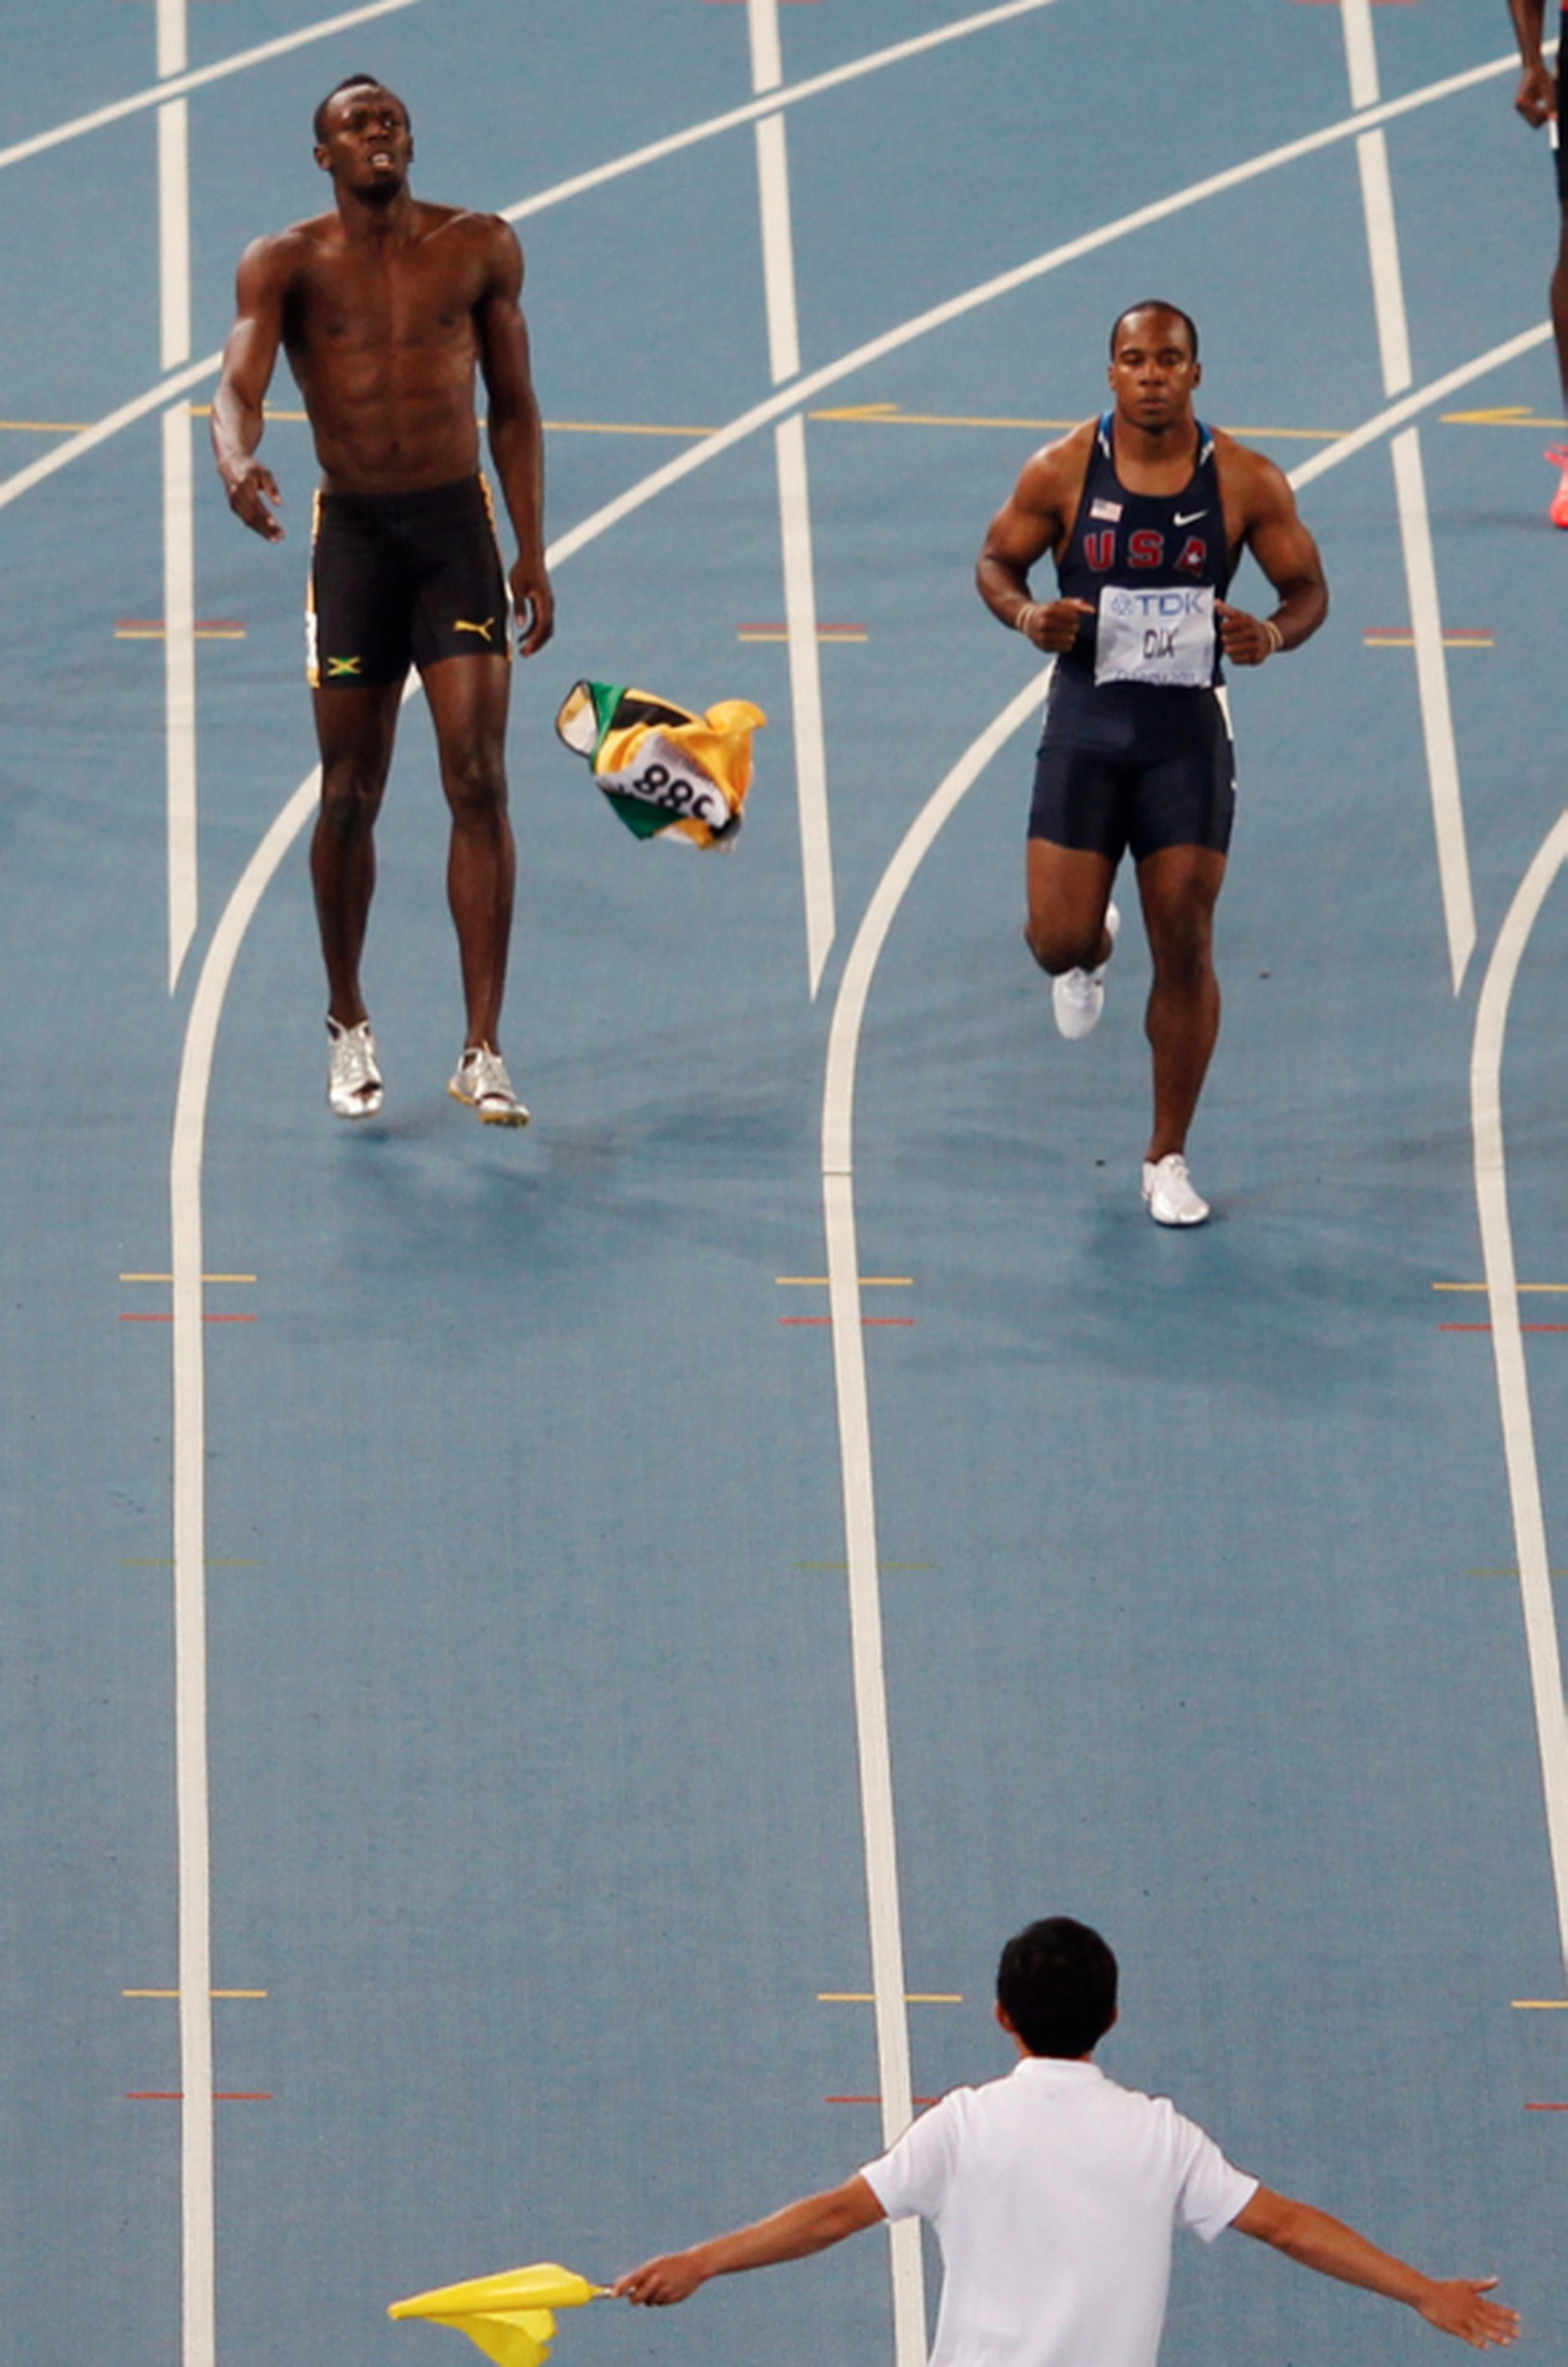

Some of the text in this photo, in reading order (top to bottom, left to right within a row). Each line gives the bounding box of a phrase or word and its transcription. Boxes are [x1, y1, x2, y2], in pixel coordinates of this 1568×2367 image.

[1084, 529, 1207, 576] USA
[1136, 594, 1202, 616] TDK
[1143, 629, 1177, 658] DIX
